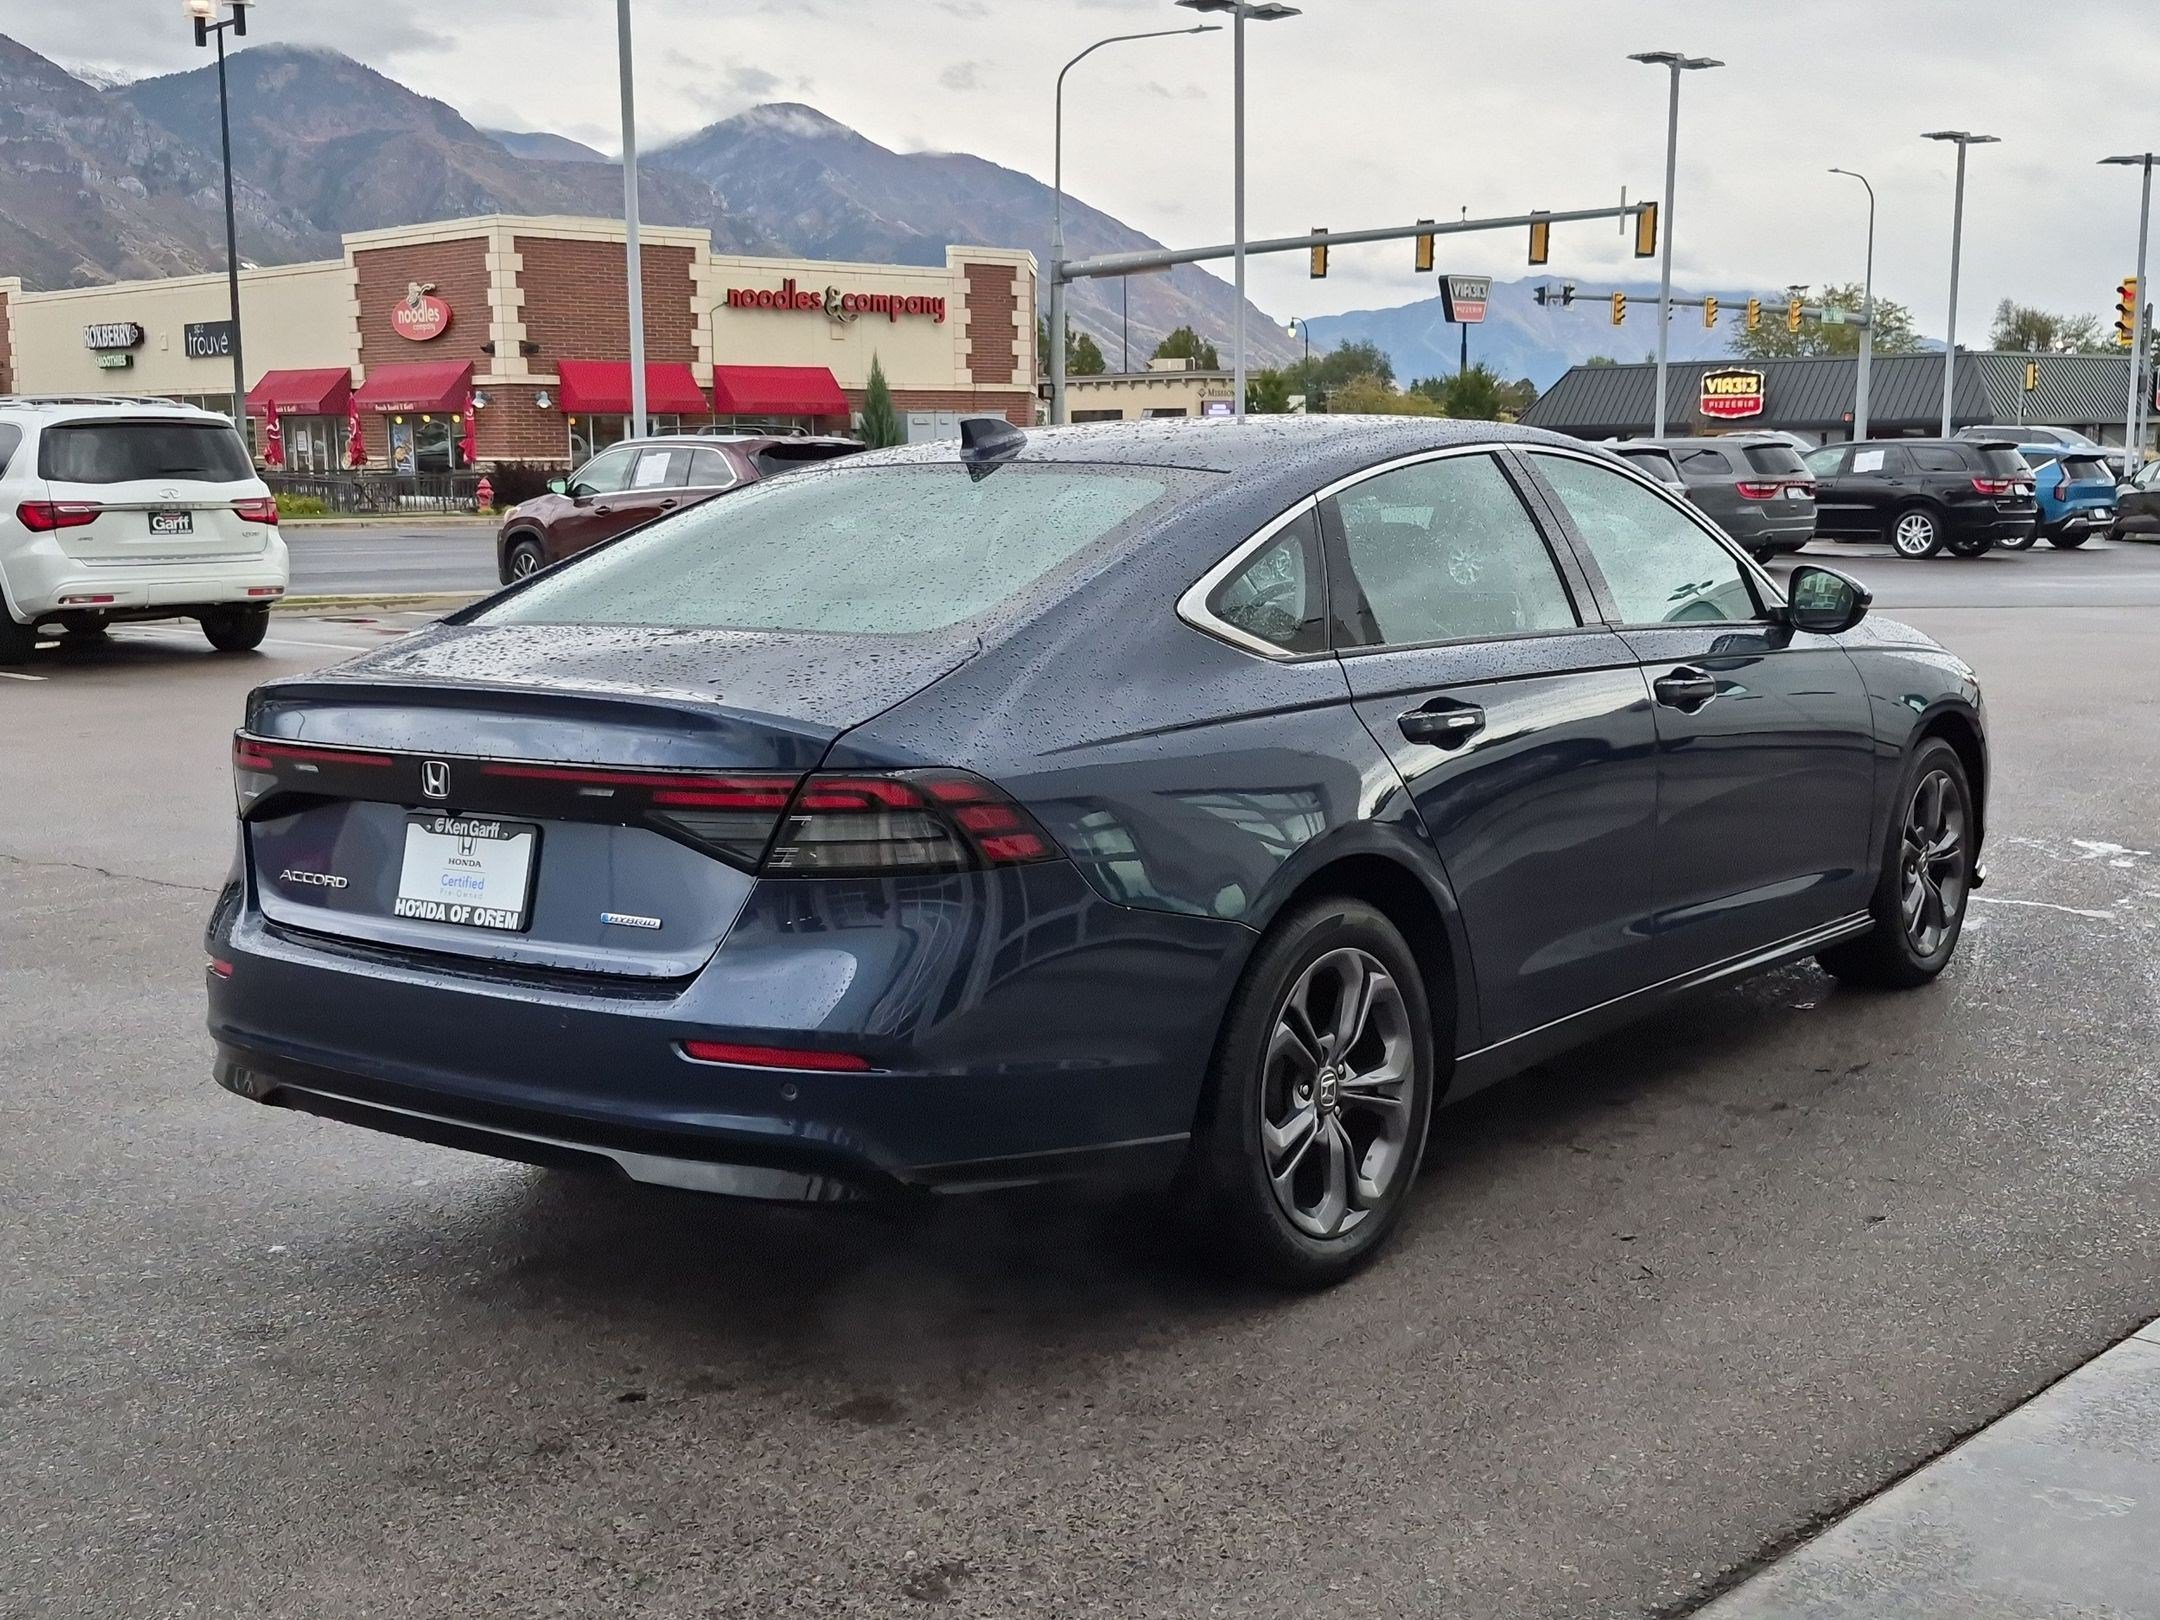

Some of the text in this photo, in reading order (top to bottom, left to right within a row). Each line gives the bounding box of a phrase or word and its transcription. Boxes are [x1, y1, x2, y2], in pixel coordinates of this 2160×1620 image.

[727, 278, 945, 325] noodles & company
[397, 299, 440, 324] noodles
[84, 323, 132, 348] ROXBERRY
[1708, 400, 1754, 409] PIZZERIA
[152, 516, 189, 530] Garff
[445, 818, 501, 839] Ken Garff
[448, 857, 482, 868] HONDA
[280, 869, 348, 888] ACCORD
[441, 873, 485, 890] Certified
[394, 898, 519, 930] HONDA OF OREM
[609, 916, 657, 927] HYBRID
